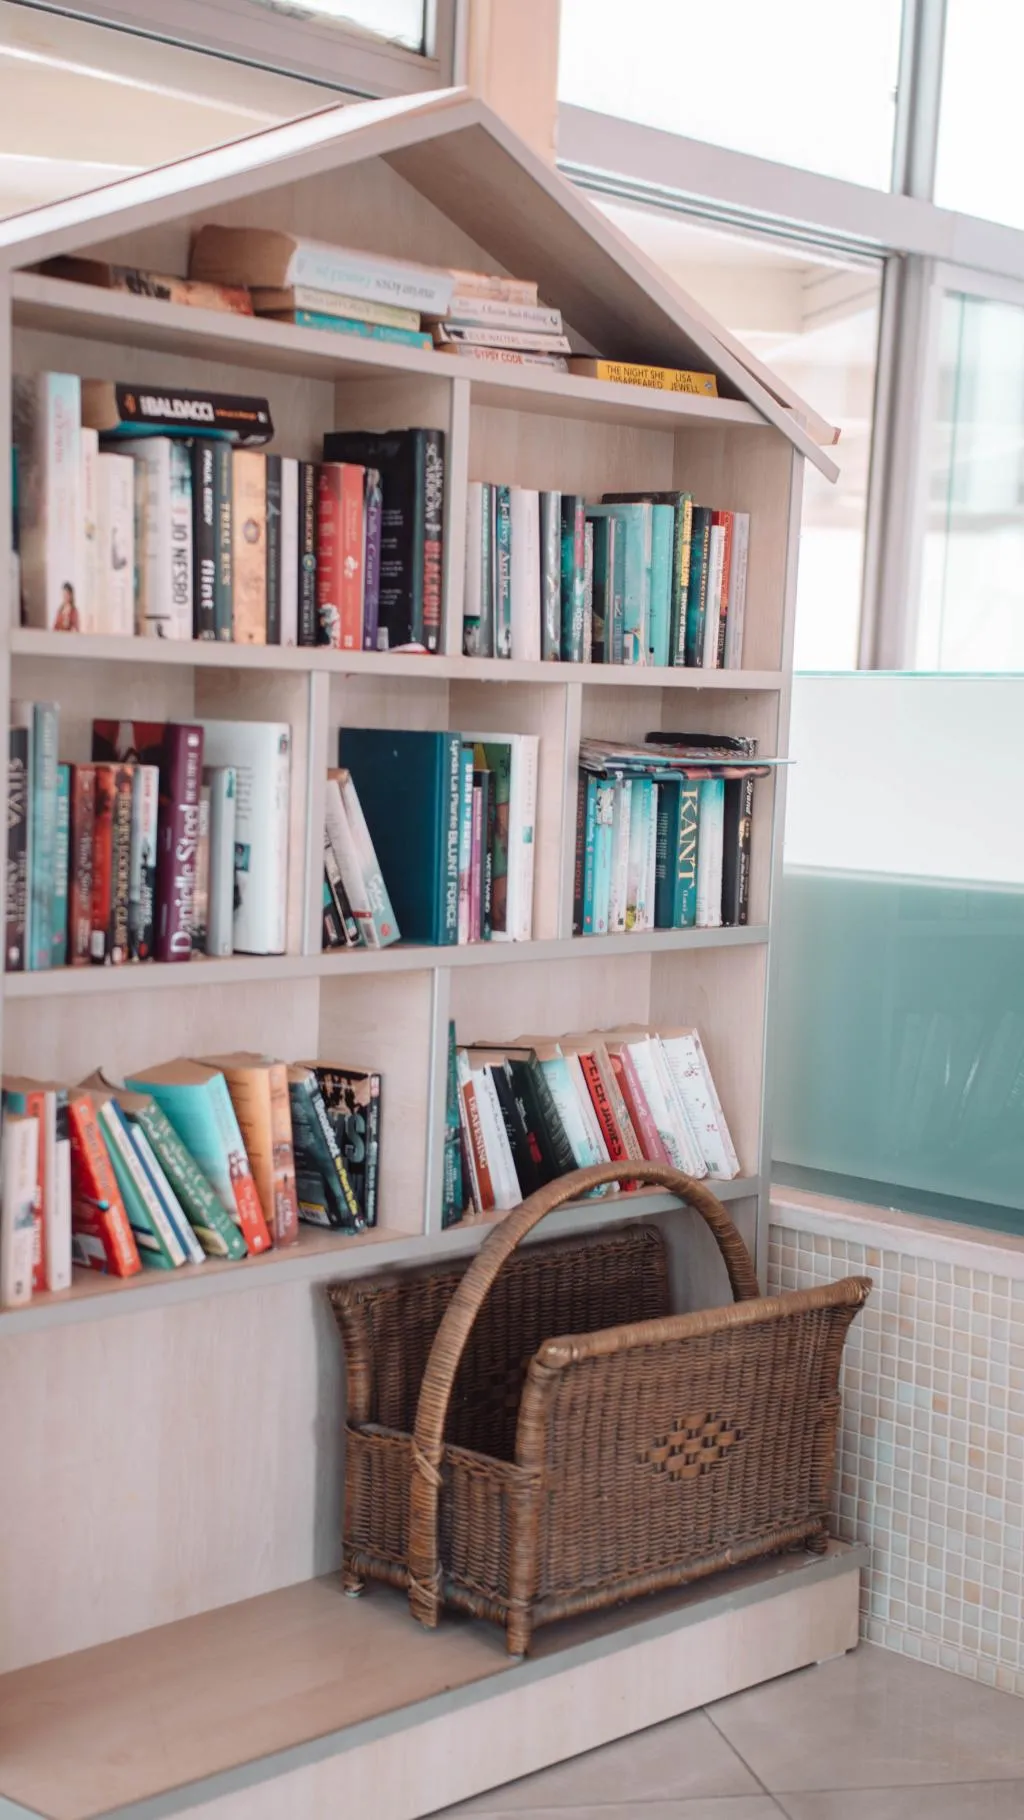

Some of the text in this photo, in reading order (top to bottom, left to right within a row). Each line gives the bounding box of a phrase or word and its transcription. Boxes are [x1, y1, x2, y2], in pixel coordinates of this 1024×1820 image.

[606, 365, 665, 381] THE NIGHT SHE
[671, 382, 700, 394] JEWELL
[675, 373, 692, 382] LISA
[149, 397, 215, 421] BALDACCI
[172, 520, 188, 541] JO
[499, 498, 511, 544] Jeffrey
[200, 560, 215, 610] flint
[424, 540, 441, 626] BLACKOUT
[700, 563, 708, 612] DETECTIVE
[8, 758, 24, 829] SILVA
[449, 740, 459, 830] Lynda La Plante
[175, 804, 199, 861] Steel
[678, 788, 698, 889] KANT
[170, 863, 194, 953] Danielle
[446, 831, 459, 929] BLUNT FORCE
[469, 1095, 489, 1169] DEAFENING
[586, 1055, 622, 1157] PETER JAMES
